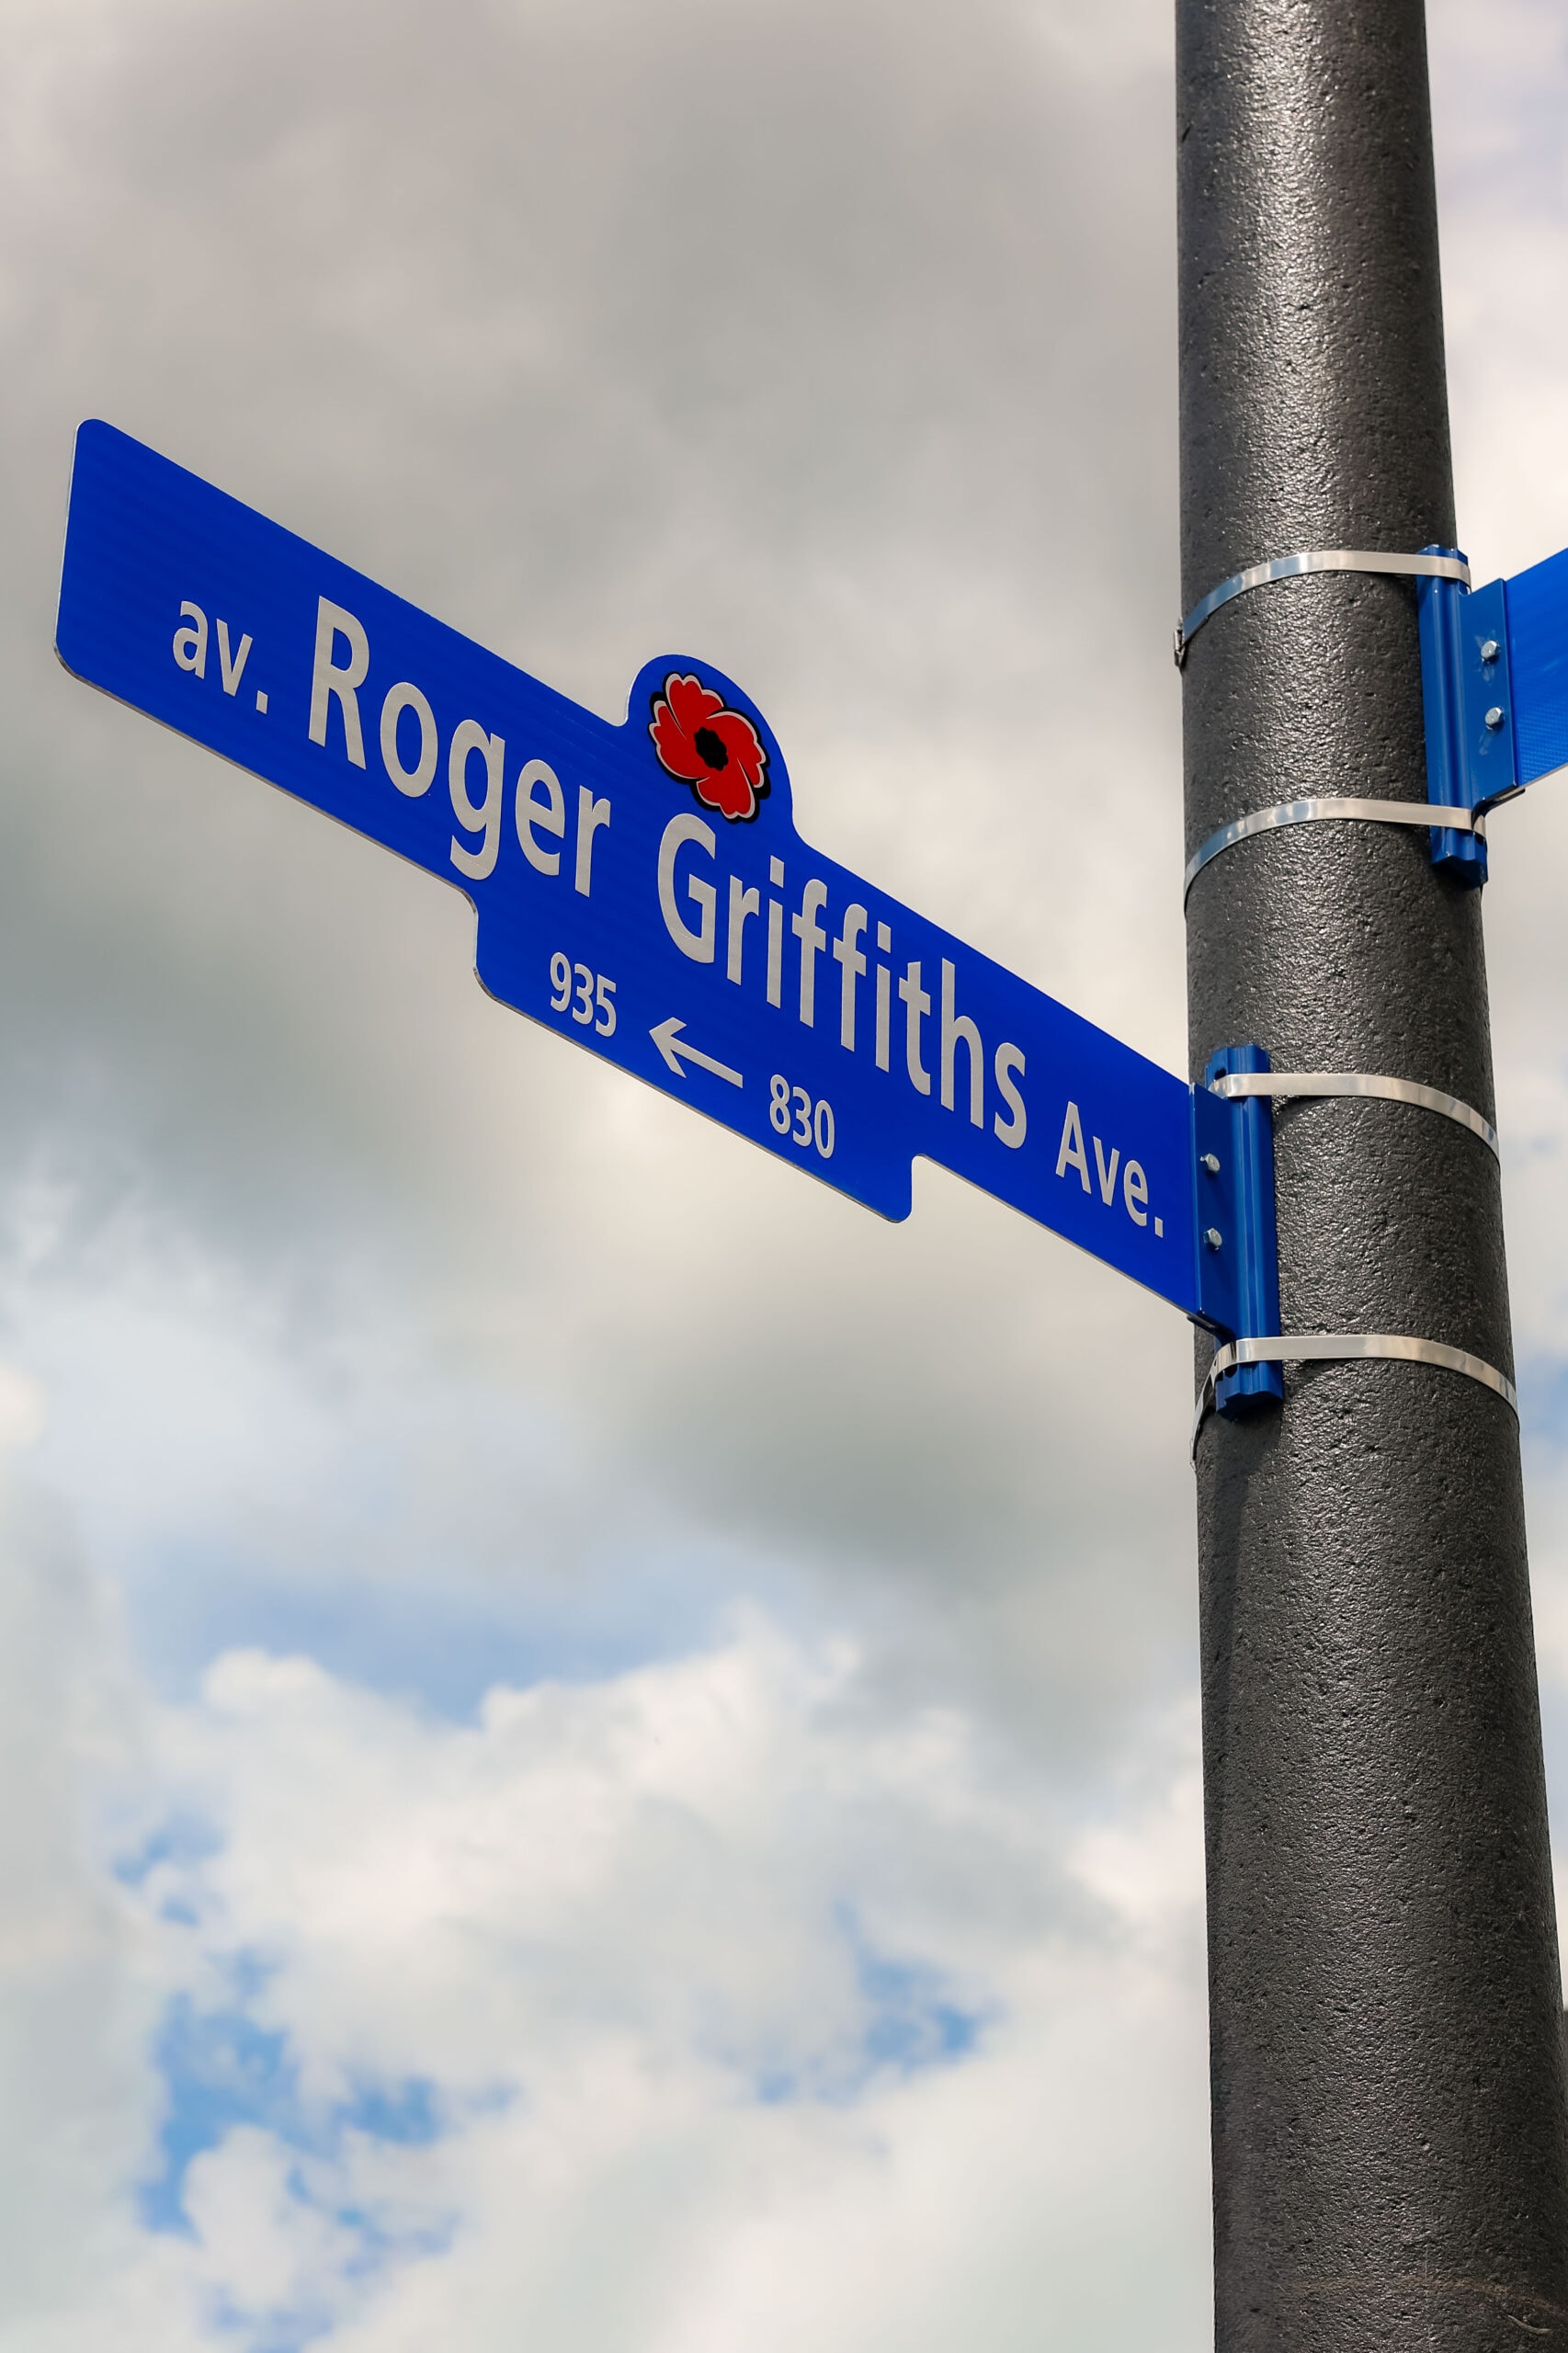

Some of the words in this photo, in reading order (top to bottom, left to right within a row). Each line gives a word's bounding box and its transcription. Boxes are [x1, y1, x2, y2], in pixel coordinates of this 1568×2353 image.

[172, 600, 268, 714] av.
[308, 595, 611, 898] Roger
[657, 813, 1027, 1149] Griffiths
[1055, 1100, 1164, 1238] Ave.
[550, 951, 617, 1037] 935
[769, 1074, 835, 1159] 830
